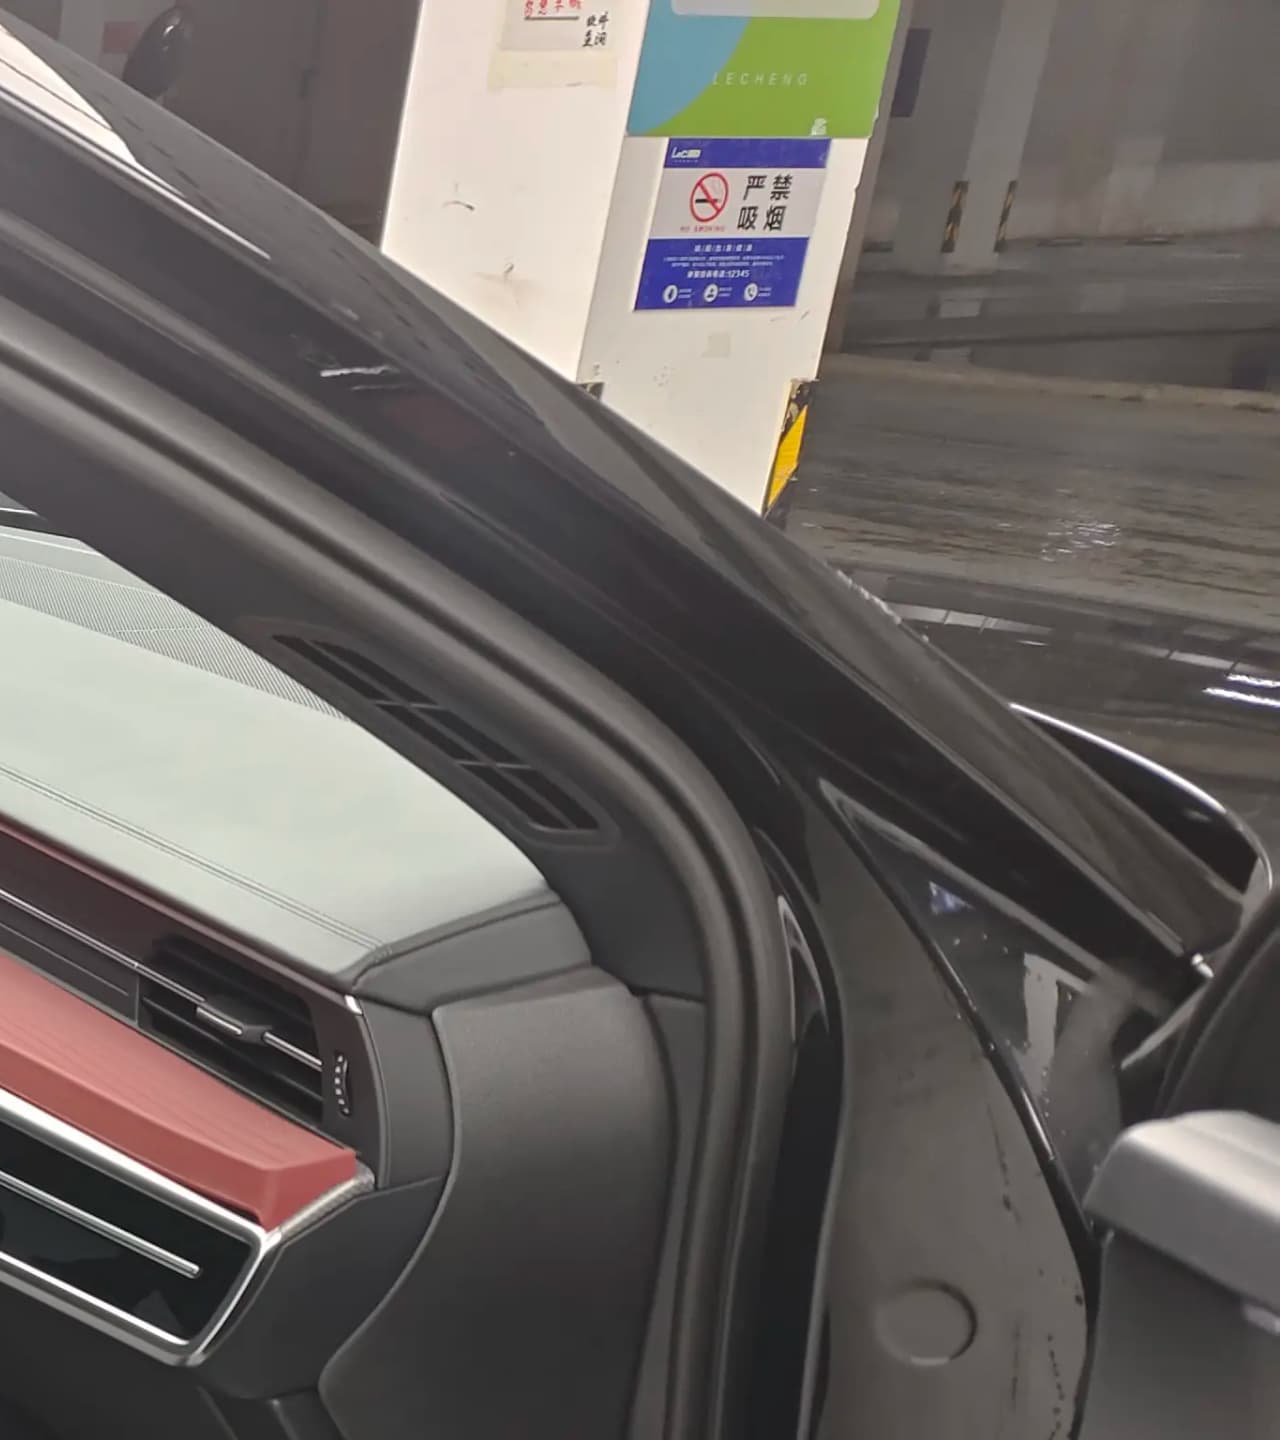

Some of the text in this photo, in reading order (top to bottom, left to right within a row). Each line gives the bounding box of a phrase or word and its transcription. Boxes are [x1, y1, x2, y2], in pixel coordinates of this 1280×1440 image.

[712, 72, 808, 86] LECHENG
[743, 174, 792, 201] 严禁
[737, 205, 786, 231] 吸烟
